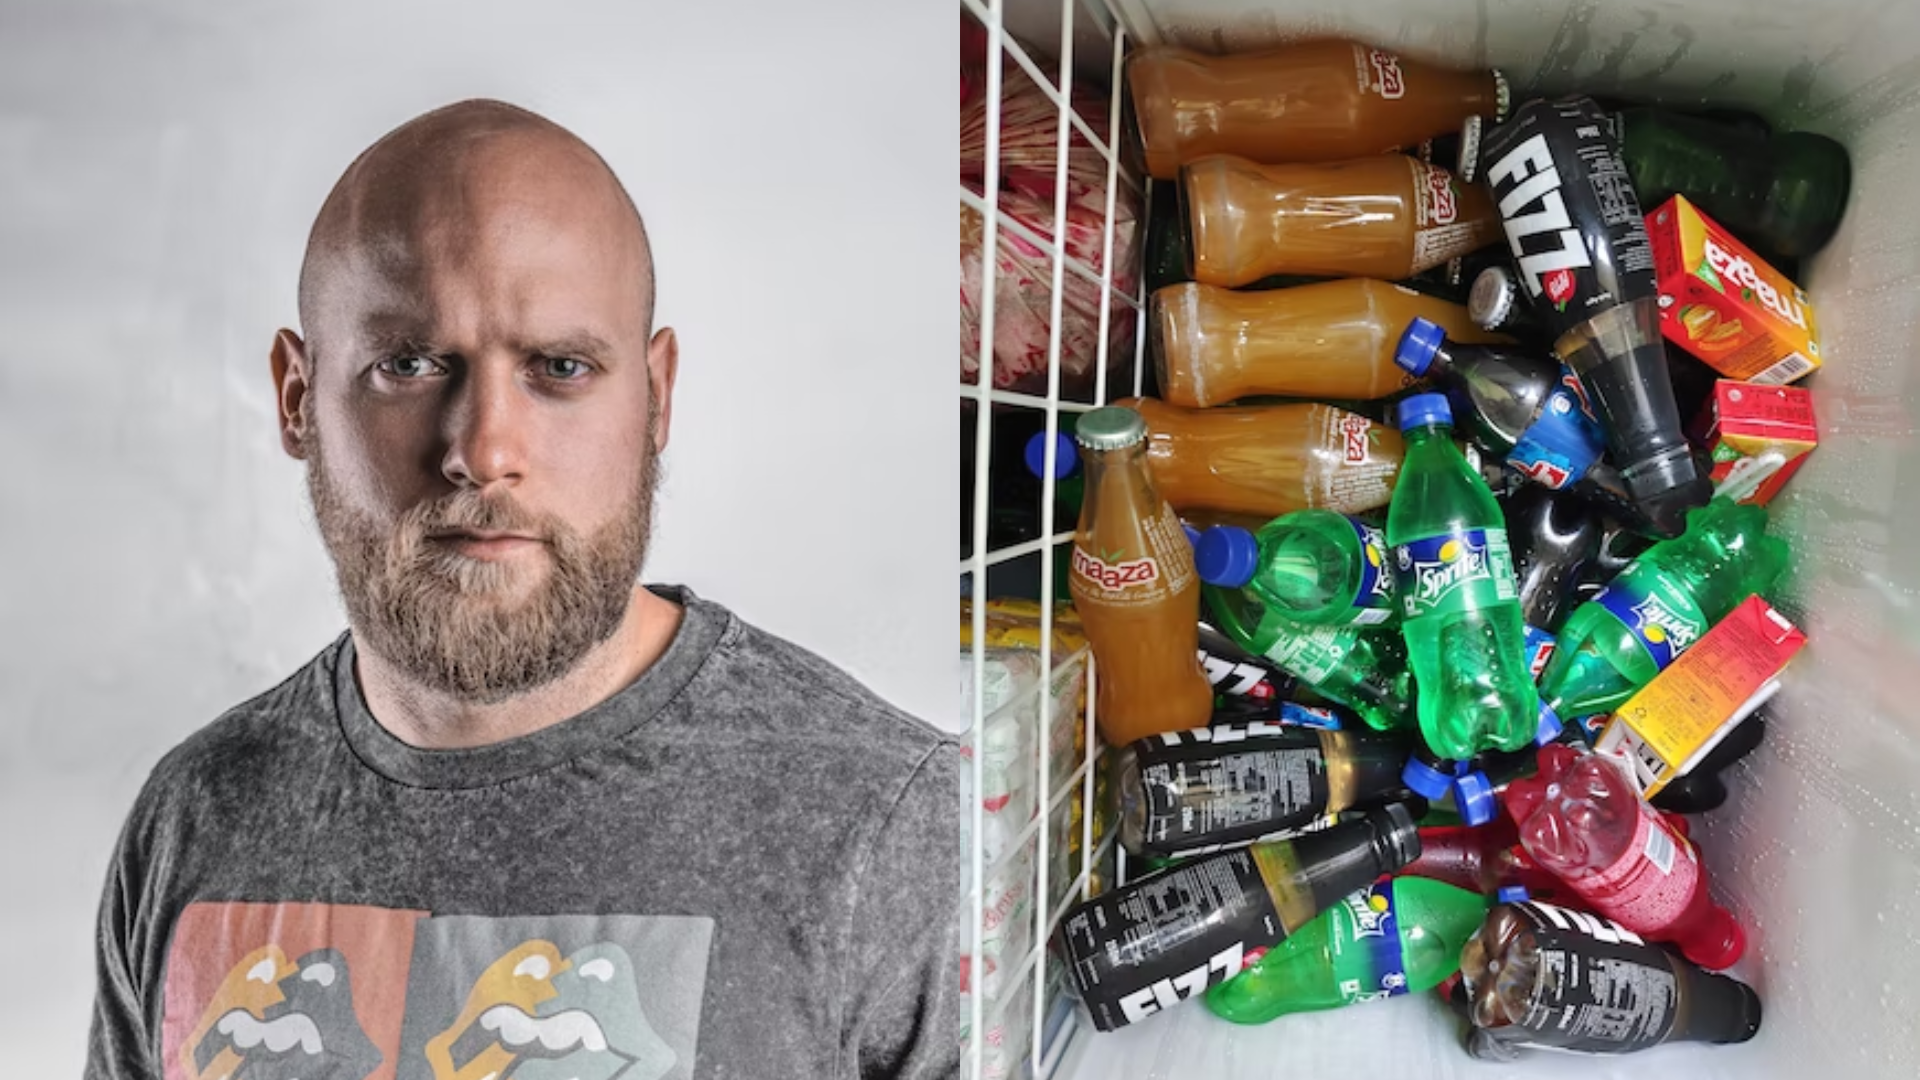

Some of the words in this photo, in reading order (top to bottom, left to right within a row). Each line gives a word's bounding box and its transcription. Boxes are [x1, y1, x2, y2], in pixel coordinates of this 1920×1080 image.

[1488, 133, 1591, 298] FIZZ
[1705, 238, 1808, 331] maaza
[1074, 546, 1157, 590] maaza
[1420, 548, 1482, 600] Sprite
[1641, 605, 1697, 647] Sprite
